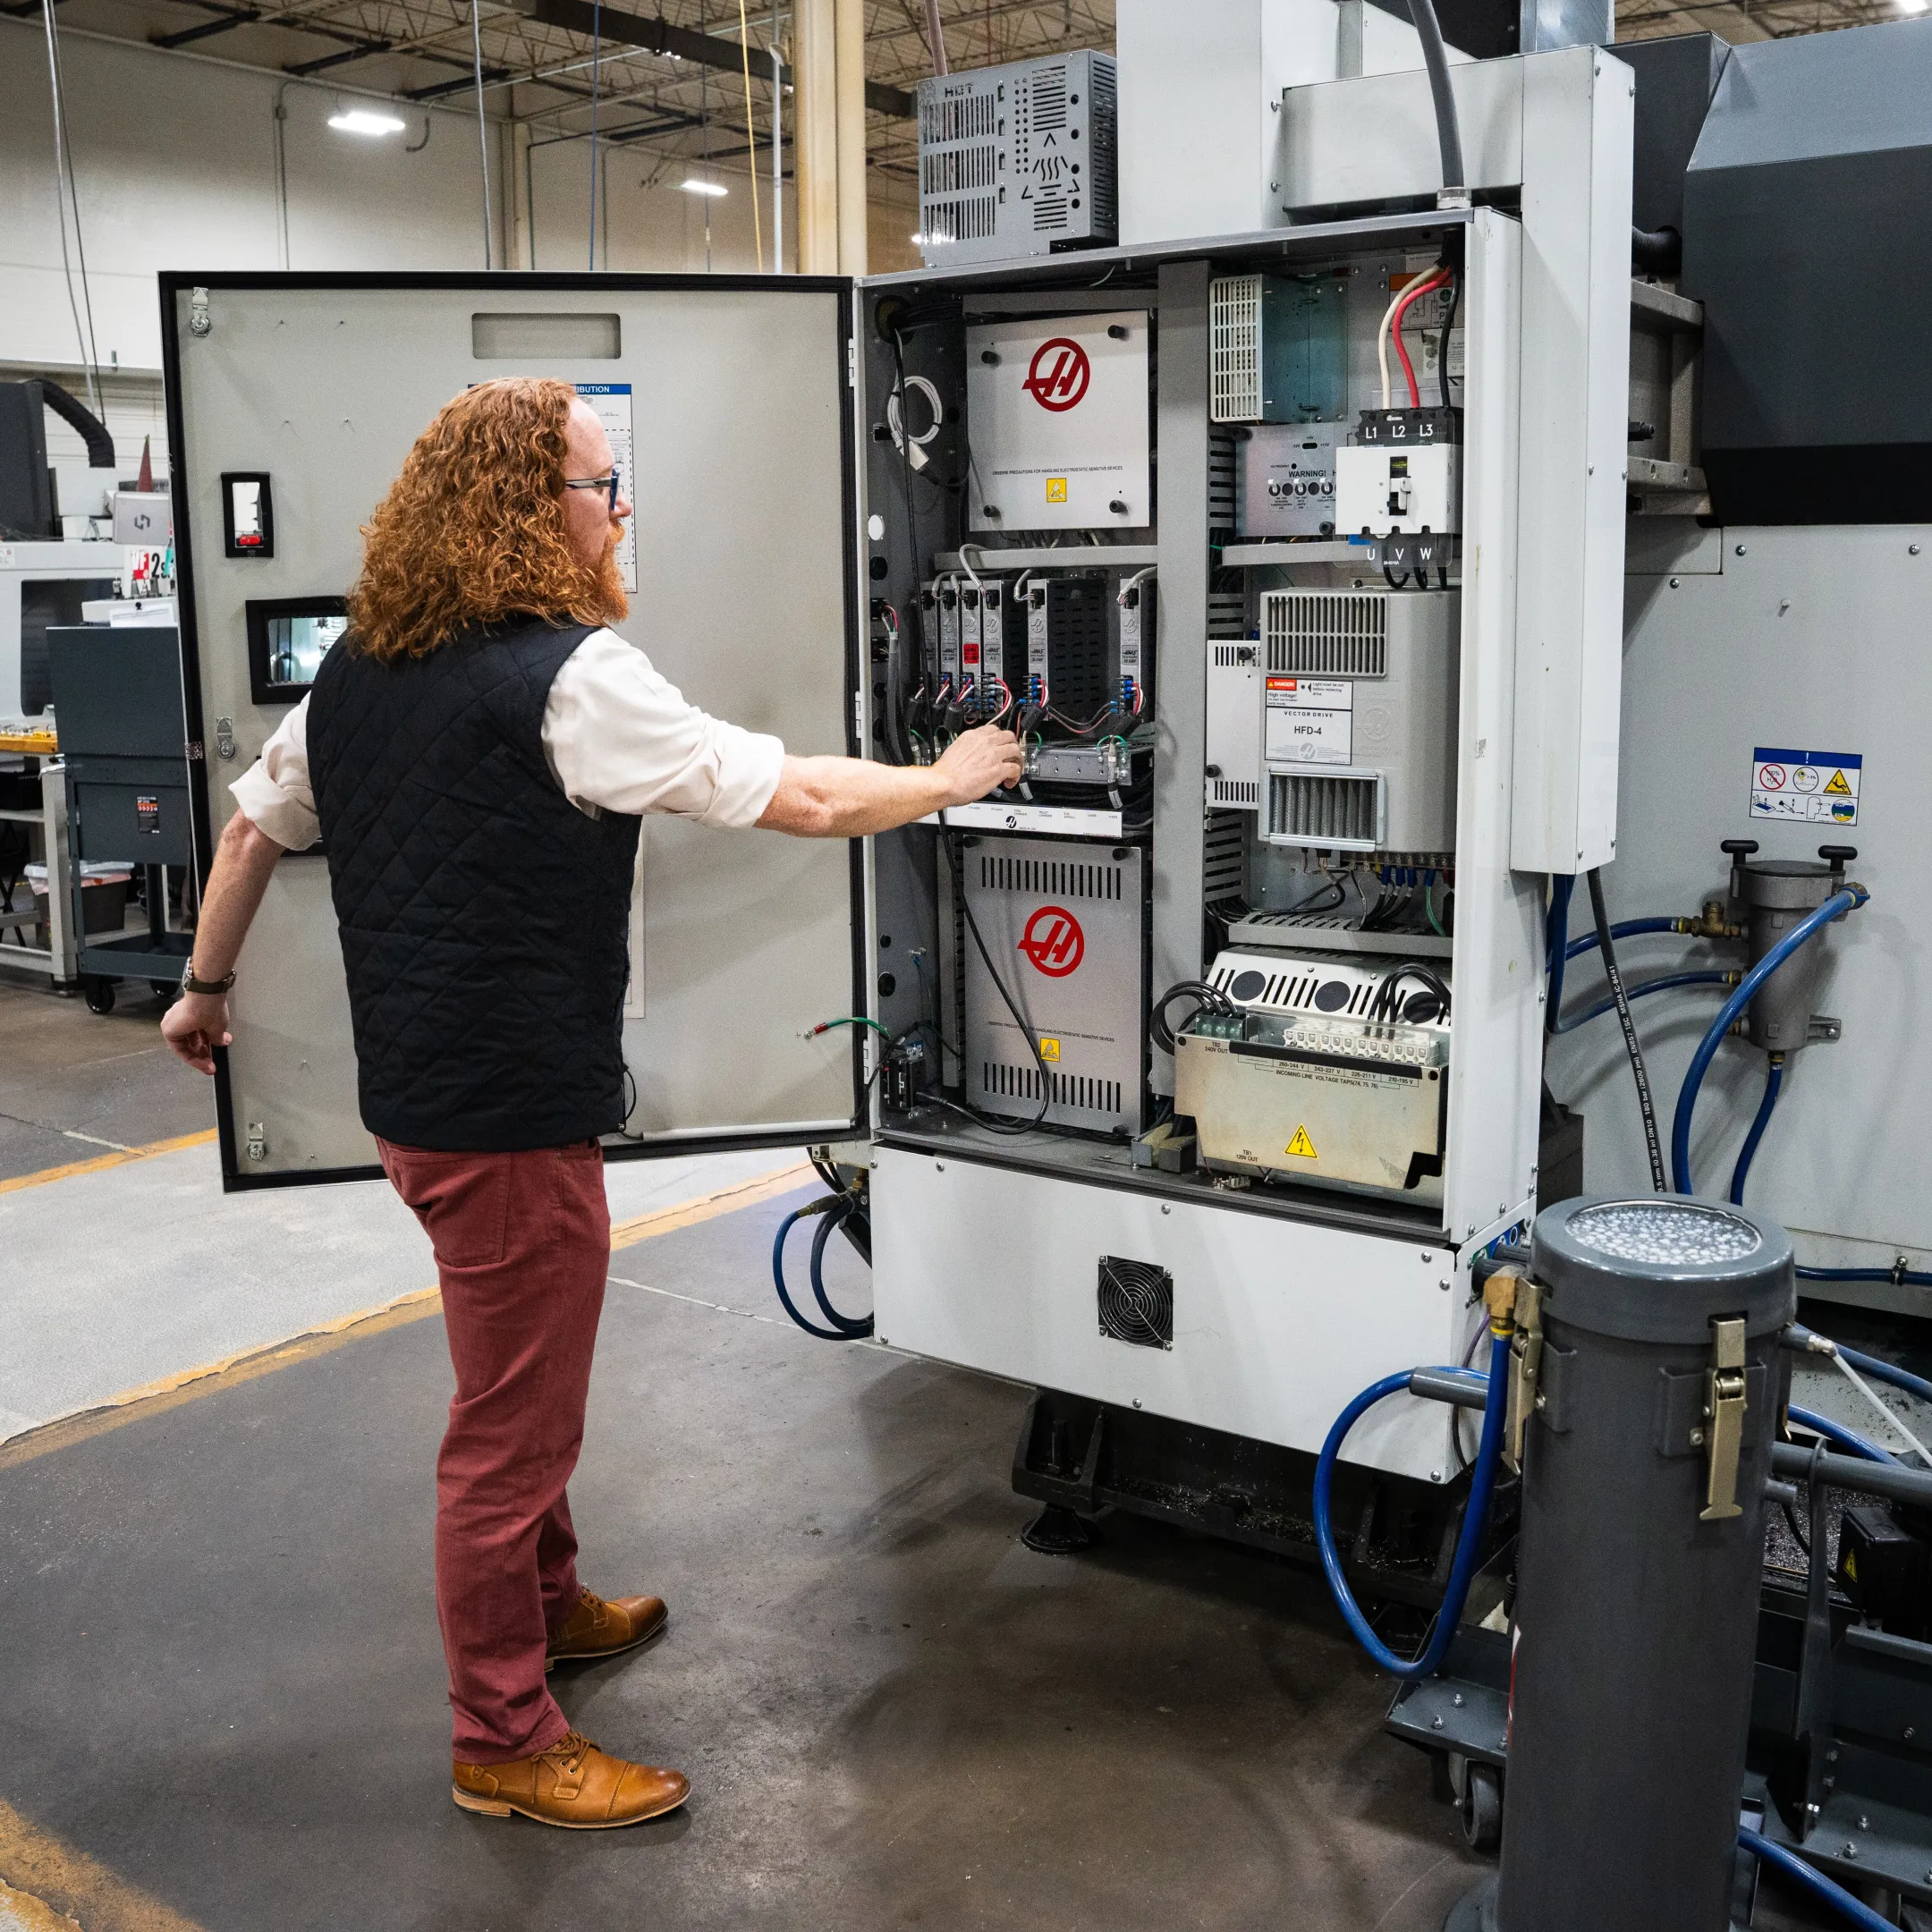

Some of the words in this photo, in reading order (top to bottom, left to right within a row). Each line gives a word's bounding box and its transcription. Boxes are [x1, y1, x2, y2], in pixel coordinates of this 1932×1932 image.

[945, 83, 973, 97] HOT
[572, 386, 610, 394] RIBUTION
[1365, 427, 1377, 438] L1
[1392, 426, 1406, 438] L2
[1419, 424, 1433, 436] L3
[1288, 470, 1326, 478] WARNING!
[1367, 547, 1376, 560] U
[1395, 547, 1404, 560] V
[1420, 547, 1431, 560] W
[1294, 725, 1322, 735] HFD-4
[1609, 966, 1621, 993] IC-84/41
[1616, 994, 1626, 1014] MSHA
[1623, 1017, 1631, 1030] 1SC
[1627, 1032, 1637, 1054] EN857
[1279, 1061, 1299, 1069] 260-244
[1276, 1070, 1301, 1078] INCOMING
[1315, 1075, 1339, 1083] VOLTAGE
[1340, 1079, 1361, 1087] TAPS(74,
[1637, 1070, 1646, 1089] (2600
[1646, 1119, 1655, 1138] DN10
[1651, 1148, 1659, 1166] (0.38
[1656, 1167, 1662, 1180] mm
